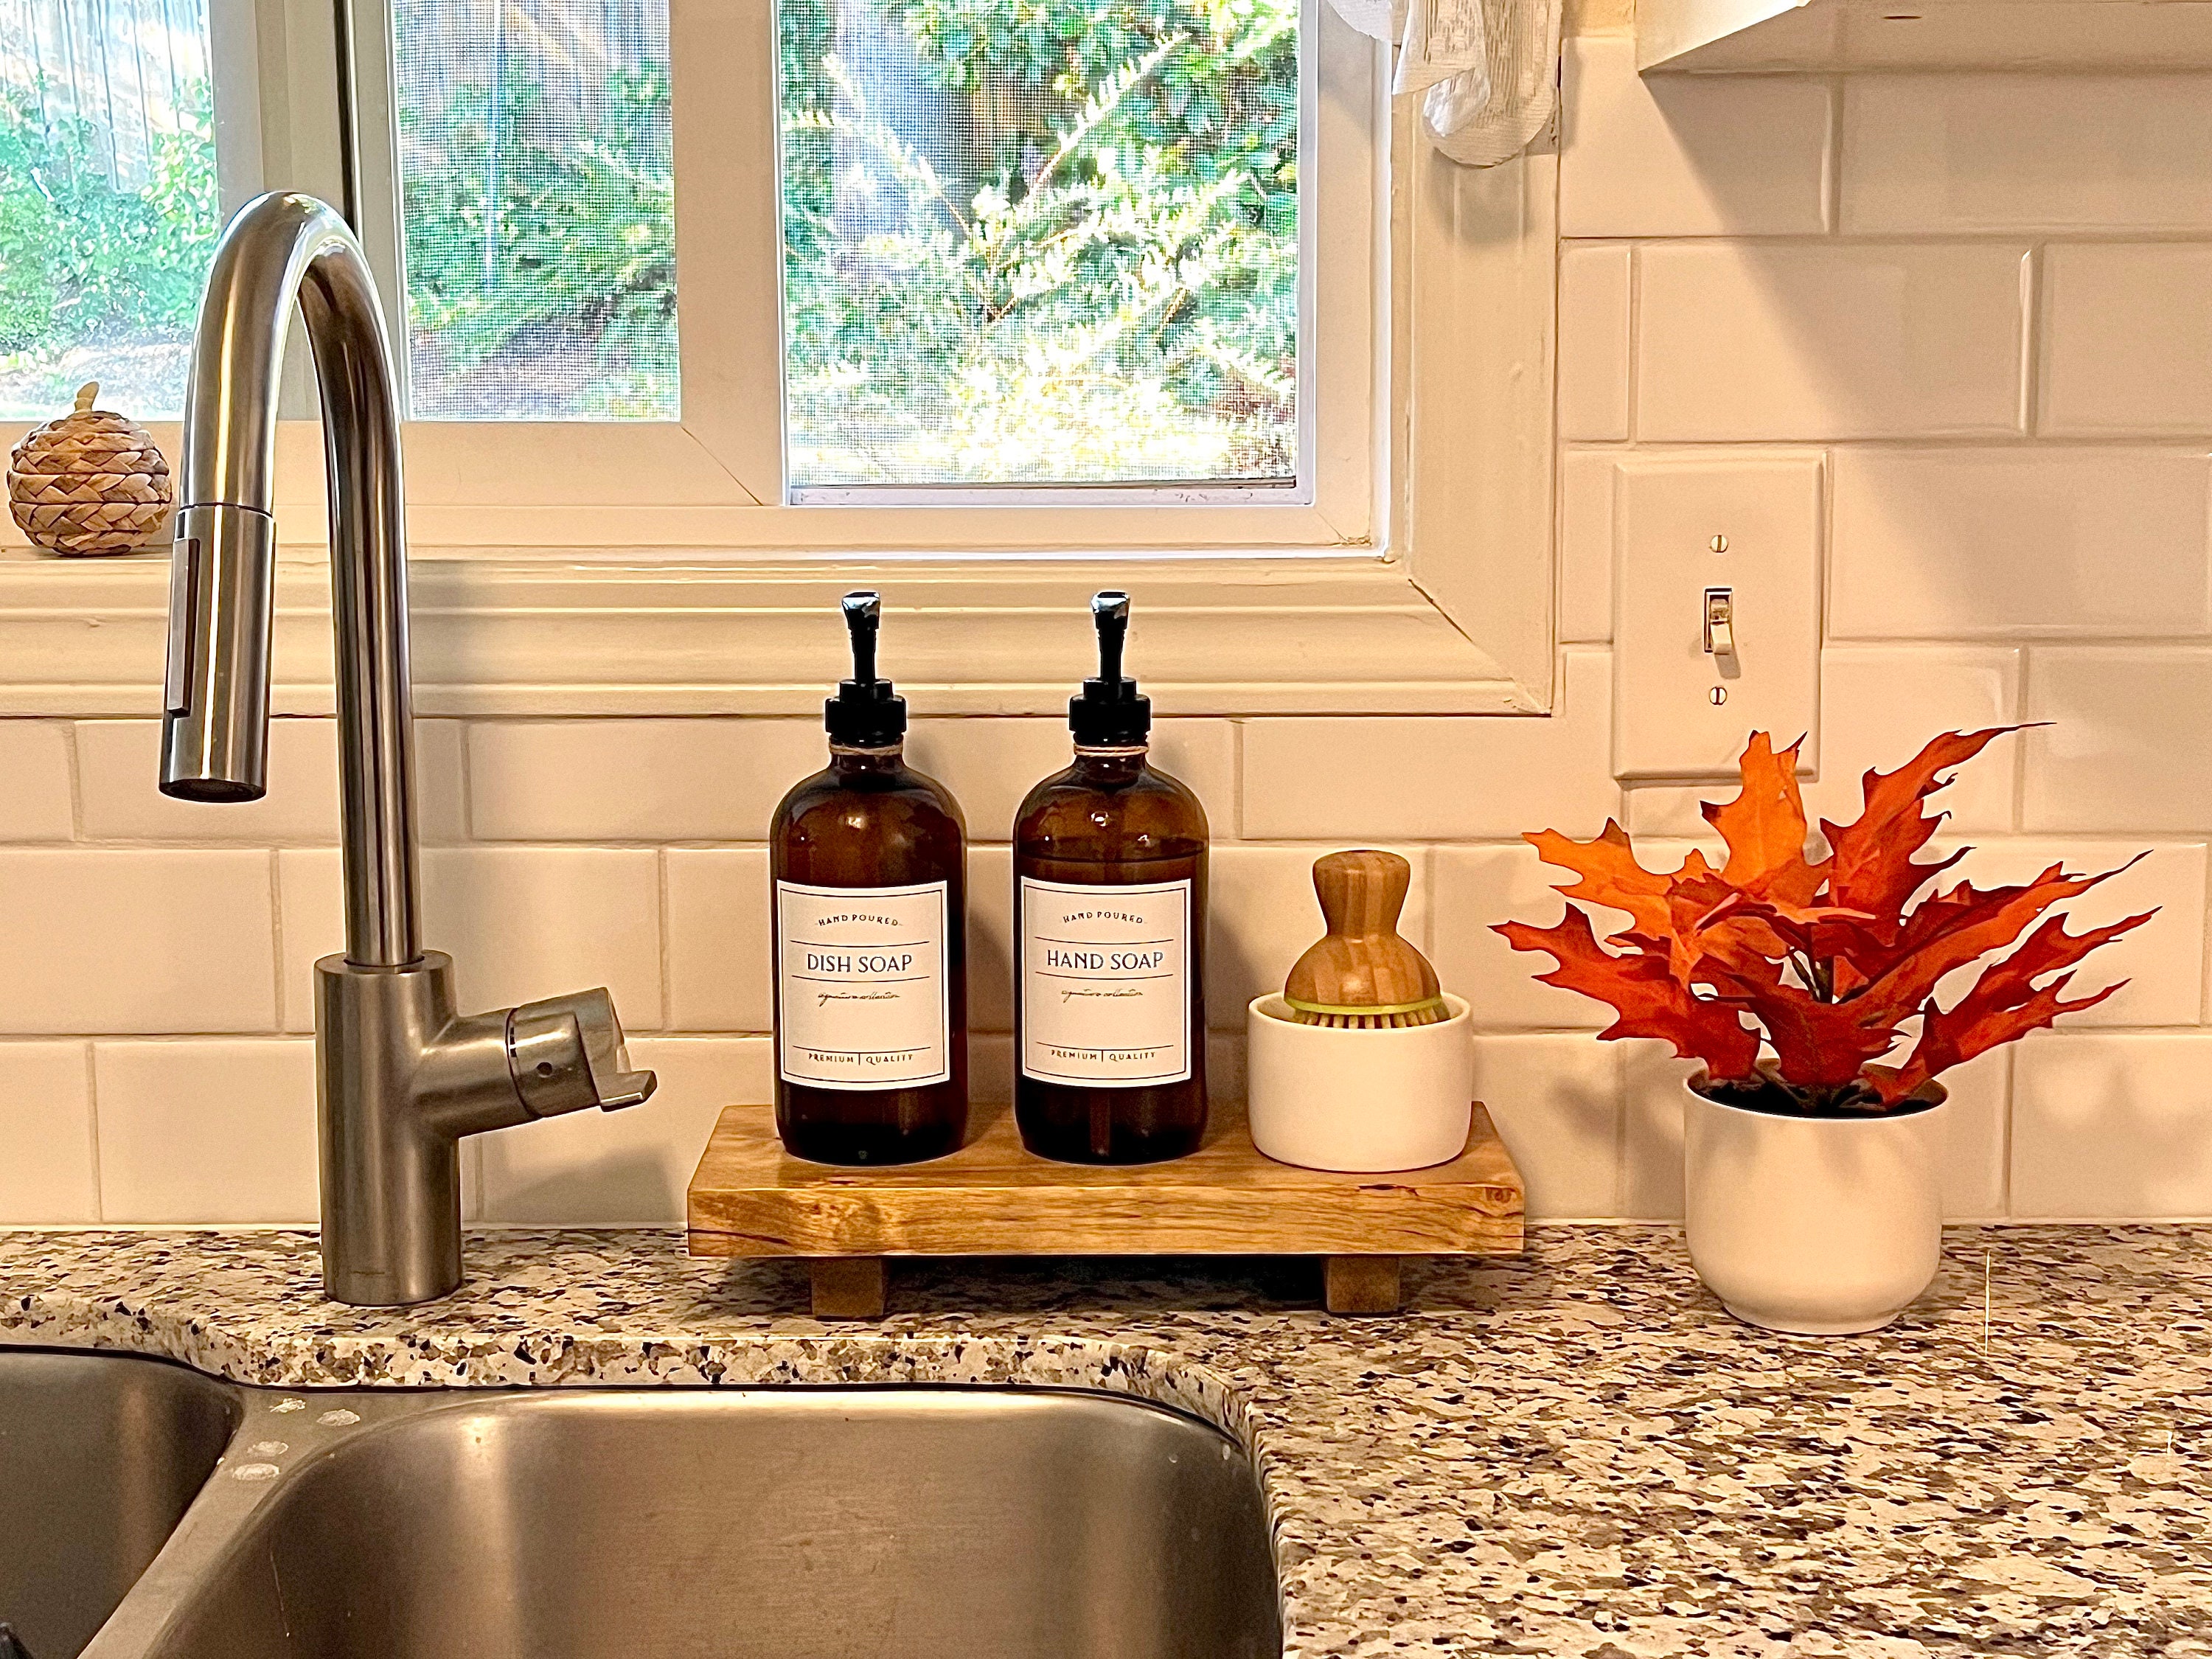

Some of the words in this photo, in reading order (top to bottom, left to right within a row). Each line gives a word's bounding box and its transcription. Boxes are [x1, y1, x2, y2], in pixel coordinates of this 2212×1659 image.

[818, 914, 848, 926] HAND
[852, 914, 898, 926] POURED
[1062, 911, 1093, 923] HAND
[1097, 911, 1143, 923] POURED
[807, 953, 851, 973] DISH
[858, 954, 912, 973] SOAP
[1047, 950, 1104, 970] HAND
[1110, 952, 1164, 970] SOAP
[809, 1053, 854, 1062] PREMIUM
[866, 1054, 913, 1065] QUALITY
[1051, 1049, 1097, 1060] PREMIUM
[1109, 1051, 1155, 1062] QUALITY
